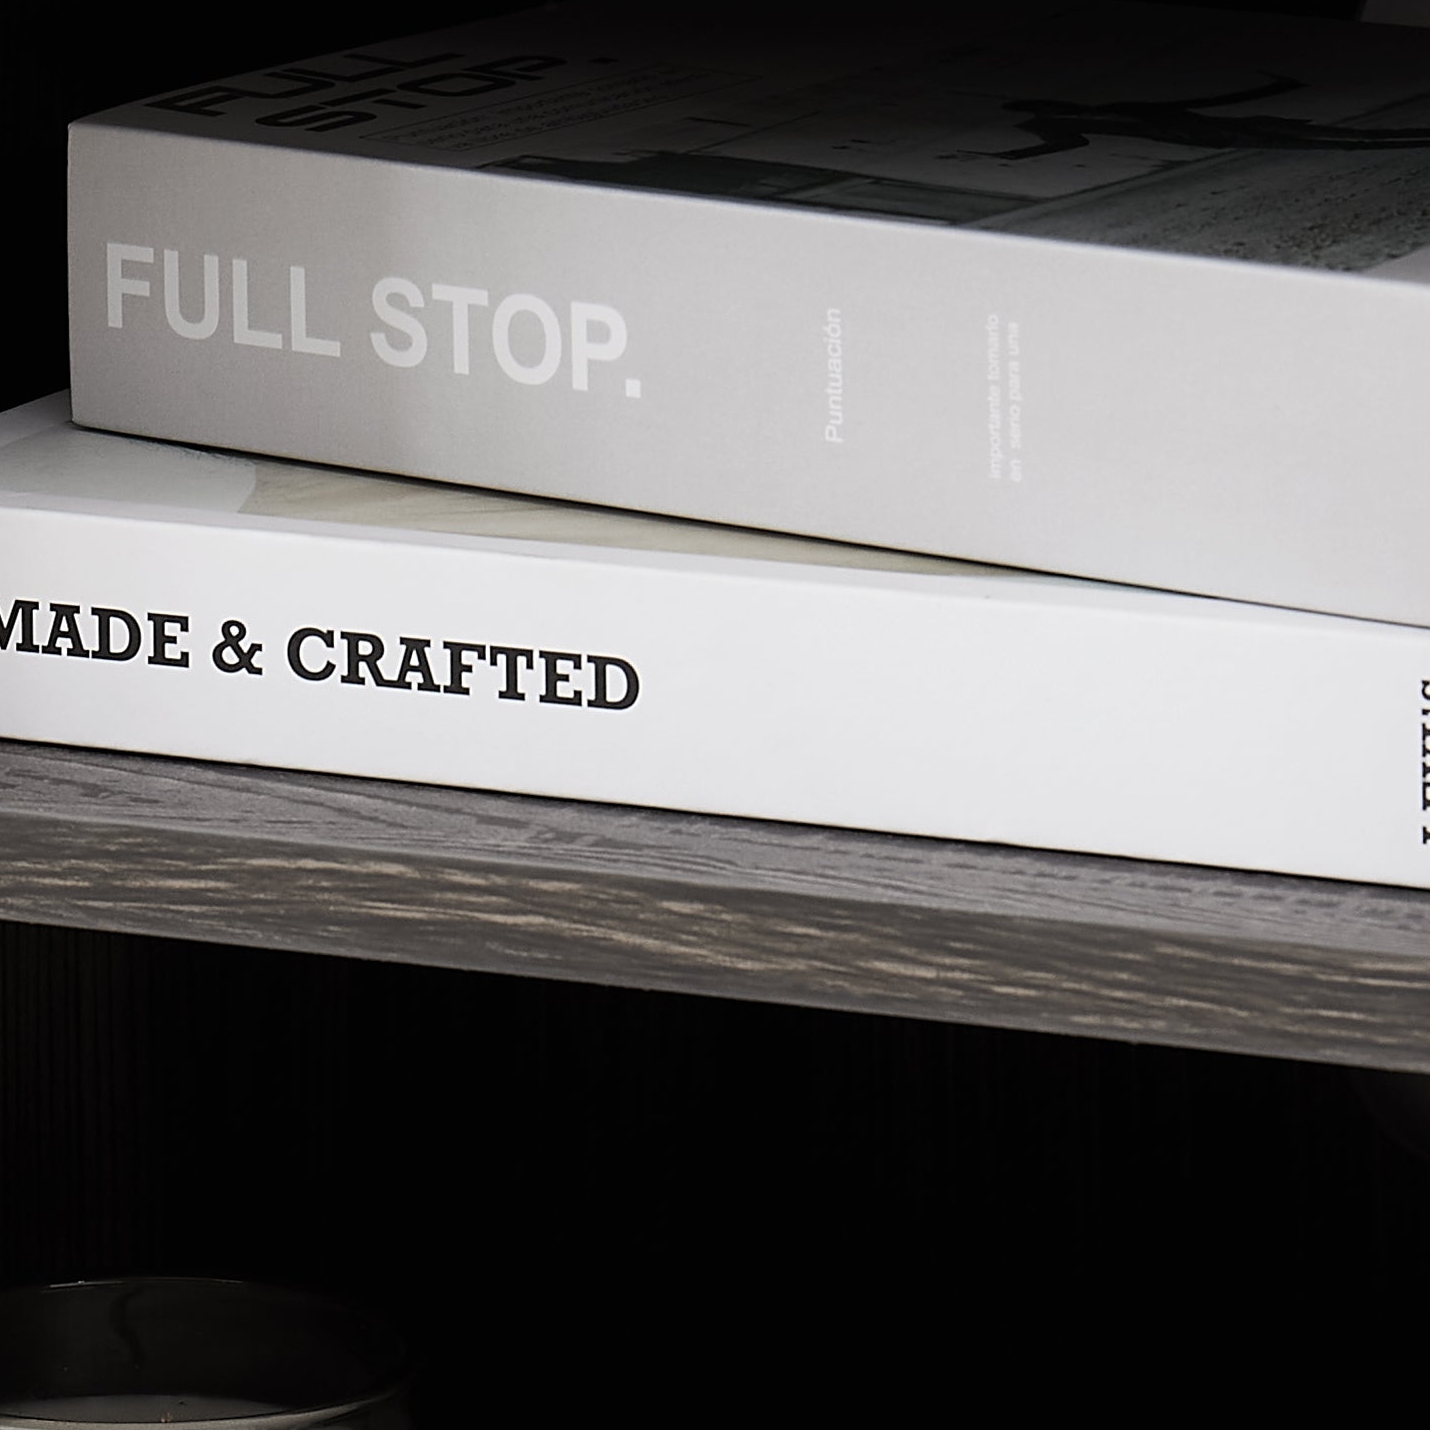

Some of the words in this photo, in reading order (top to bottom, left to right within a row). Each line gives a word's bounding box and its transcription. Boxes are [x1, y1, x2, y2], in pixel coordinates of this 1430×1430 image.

[144, 52, 468, 119] FULL
[106, 242, 341, 358] FULL
[370, 276, 642, 399] STOP.
[823, 308, 844, 444] Puntuación
[211, 619, 263, 676] &
[286, 627, 640, 711] CRAFTED
